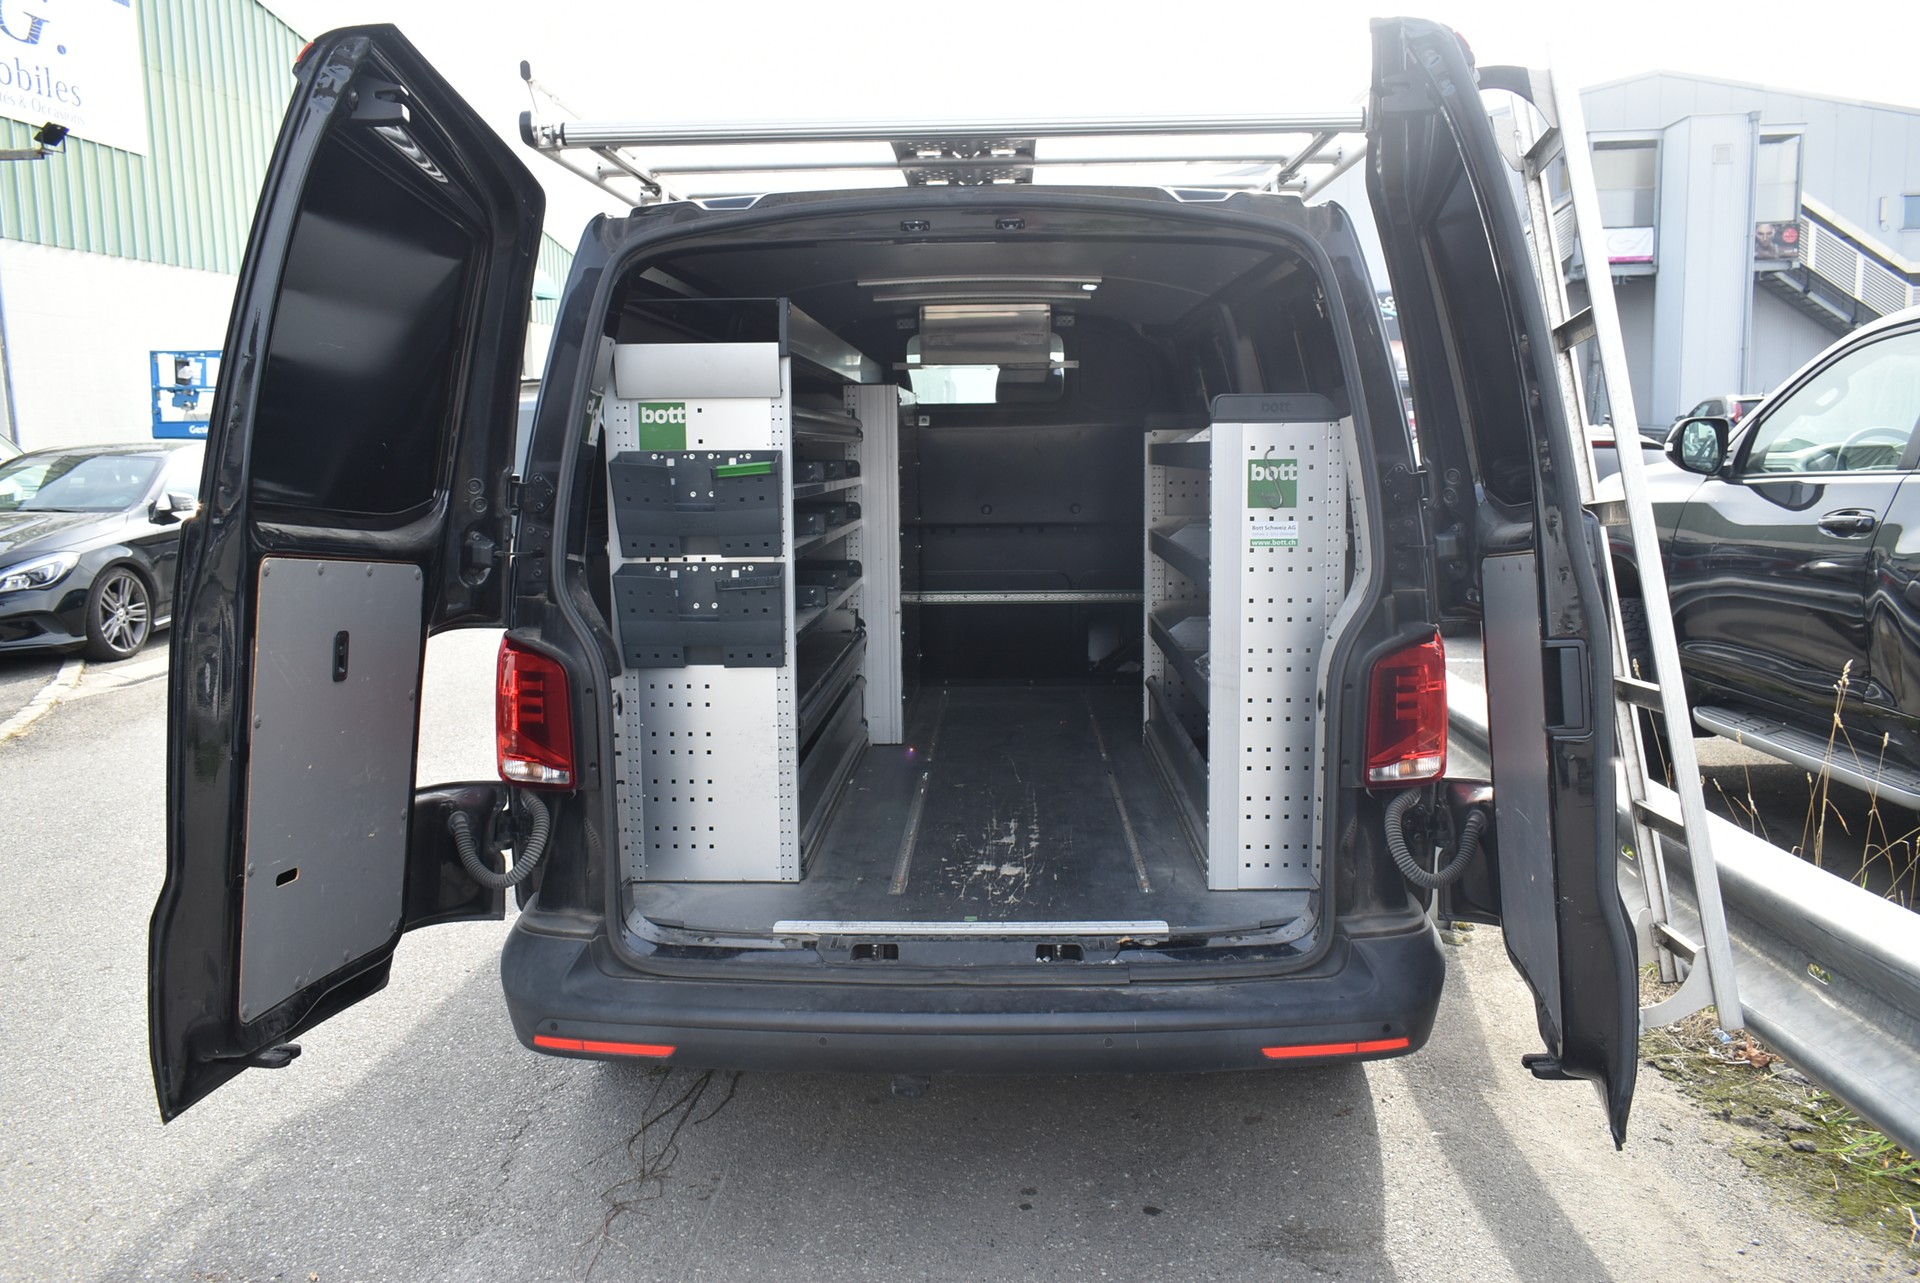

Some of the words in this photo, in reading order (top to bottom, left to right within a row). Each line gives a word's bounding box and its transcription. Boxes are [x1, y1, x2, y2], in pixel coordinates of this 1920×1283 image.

[31, 97, 85, 126] Occasions
[641, 406, 685, 425] bott
[1261, 400, 1292, 413] bott
[1251, 463, 1297, 482] bott
